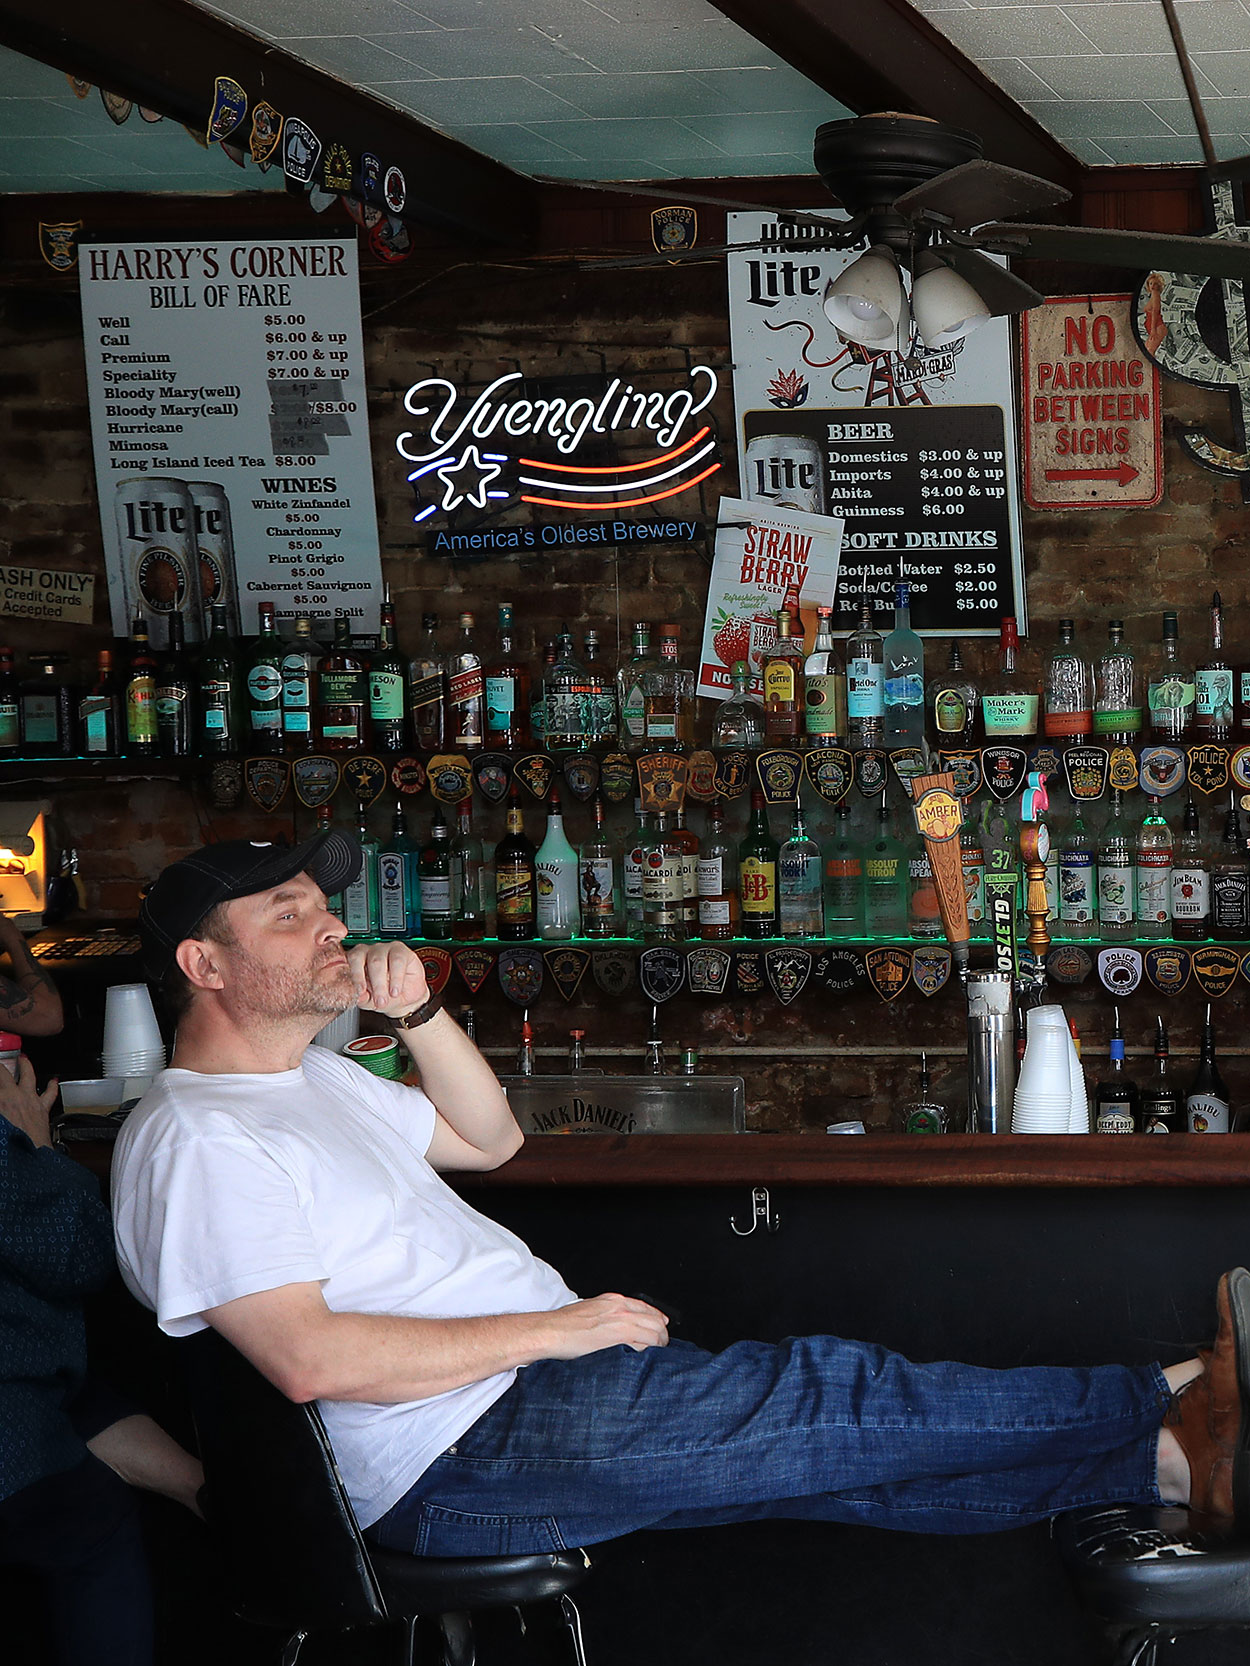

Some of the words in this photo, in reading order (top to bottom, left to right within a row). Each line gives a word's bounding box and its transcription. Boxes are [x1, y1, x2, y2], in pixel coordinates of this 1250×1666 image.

[656, 216, 691, 225] POLICE
[89, 247, 219, 281] HARRY'S
[230, 245, 348, 279] CORNER
[745, 260, 821, 308] Lite
[150, 286, 196, 309] BILL
[204, 285, 229, 307] OF
[237, 283, 292, 307] FARE
[98, 316, 130, 329] Well
[264, 314, 306, 327] $5.00
[100, 334, 130, 347] Call
[265, 332, 306, 344] $6.00
[311, 332, 324, 343] &
[328, 333, 348, 345] up
[1064, 314, 1116, 356] NO
[101, 352, 170, 364] Premium
[267, 350, 308, 362] $7.00
[103, 370, 176, 384] Speciality
[268, 367, 309, 380] $7.00
[1038, 360, 1144, 390] PARKING
[105, 387, 154, 401] Bloody
[159, 385, 241, 400] Mary(well)
[106, 405, 155, 419] Bloody
[160, 403, 239, 417] Mary(call)
[396, 366, 718, 462] Yuengling
[1034, 394, 1150, 423] BETWEEN
[108, 422, 183, 434] Hurricane
[827, 423, 894, 442] BEER
[109, 440, 169, 452] Mimosa
[1055, 427, 1130, 455] SIGNS
[110, 457, 148, 472] Long
[152, 456, 199, 468] Island
[203, 456, 234, 467] Iced
[238, 456, 266, 467] Tea
[275, 455, 316, 467] $8.00
[828, 450, 908, 463] Domestics
[918, 449, 962, 462] $3.00
[966, 448, 980, 461] &
[983, 450, 1003, 463] up
[753, 457, 815, 500] Lite
[829, 469, 892, 483] Imports
[920, 468, 963, 480] $4.00
[261, 477, 337, 494] WINES
[830, 487, 873, 500] Abita
[921, 485, 964, 498] $4.00
[252, 500, 288, 510] White
[291, 499, 351, 510] Zinfandel
[832, 504, 905, 517] Guinness
[922, 503, 965, 516] $6.00
[123, 501, 185, 543] Lite
[266, 526, 342, 538] Chardonnay
[434, 529, 535, 551] America's
[541, 525, 608, 545] Oldest
[613, 521, 697, 541] Brewery
[840, 532, 898, 549] SOFT
[905, 530, 998, 548] DRINKS
[744, 525, 813, 564] STRAW
[268, 554, 303, 564] Pinot
[306, 554, 345, 566] Grigio
[740, 554, 809, 592] BERRY
[837, 563, 893, 576] Bottled
[897, 563, 943, 575] Water
[954, 562, 996, 575] $2.50
[39, 572, 88, 592] ONLY
[247, 581, 303, 592] Cabernet
[307, 581, 372, 594] Sauvignon
[757, 585, 783, 595] LAGER
[955, 580, 998, 593] $2.00
[4, 587, 43, 603] Credit
[45, 592, 81, 606] Cards
[956, 598, 999, 611] $5.00
[2, 600, 63, 617] Accepted
[987, 699, 1026, 707] Maker's
[997, 707, 1026, 716] Mark
[1068, 756, 1104, 768] POLICE
[919, 804, 958, 821] AMBER
[991, 849, 1010, 870] 37
[532, 1104, 568, 1133] JACK
[573, 1098, 637, 1134] DANIEL'S
[1187, 1102, 1220, 1118] MALIBU
